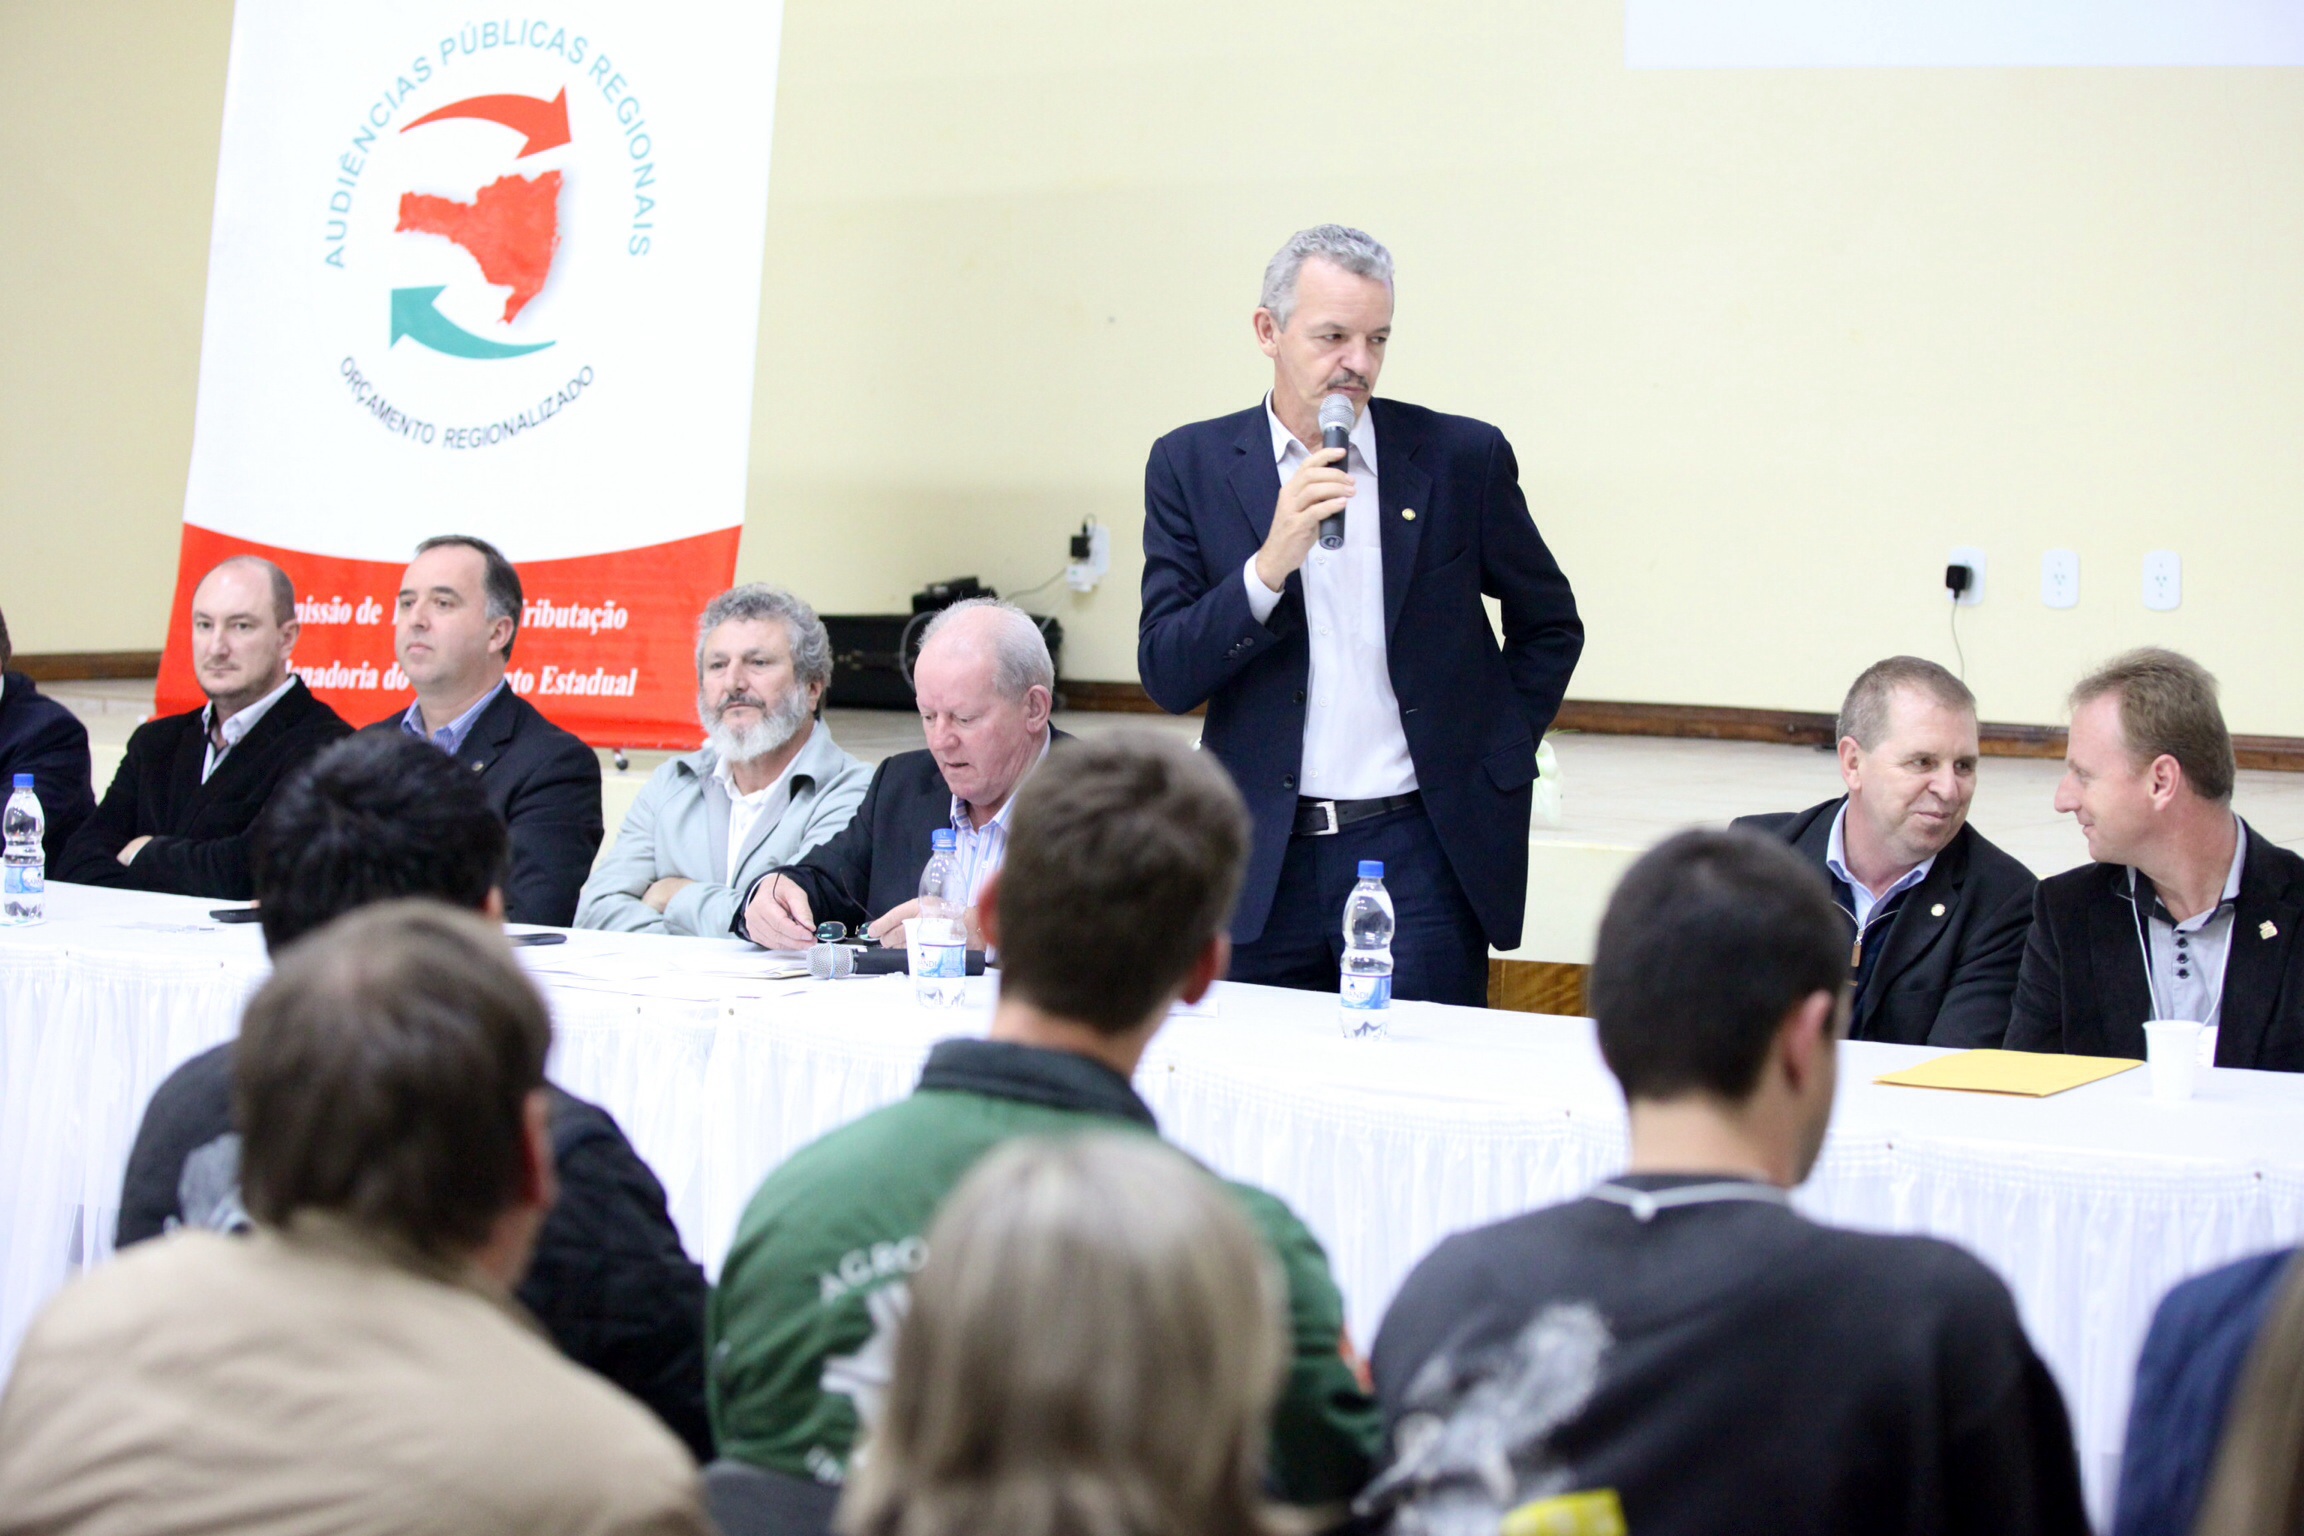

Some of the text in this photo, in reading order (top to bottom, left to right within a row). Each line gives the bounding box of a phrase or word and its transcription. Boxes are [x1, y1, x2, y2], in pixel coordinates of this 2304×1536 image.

[324, 19, 656, 269] AUDIÊNCIAS PÚBLICAS REGIONAIS
[340, 356, 594, 450] ORÇAMENTO REGIONALIZADO
[355, 596, 383, 625] de
[522, 598, 629, 636] ributação
[286, 660, 379, 690] nadoria
[382, 661, 411, 691] do
[538, 665, 638, 697] Estadual
